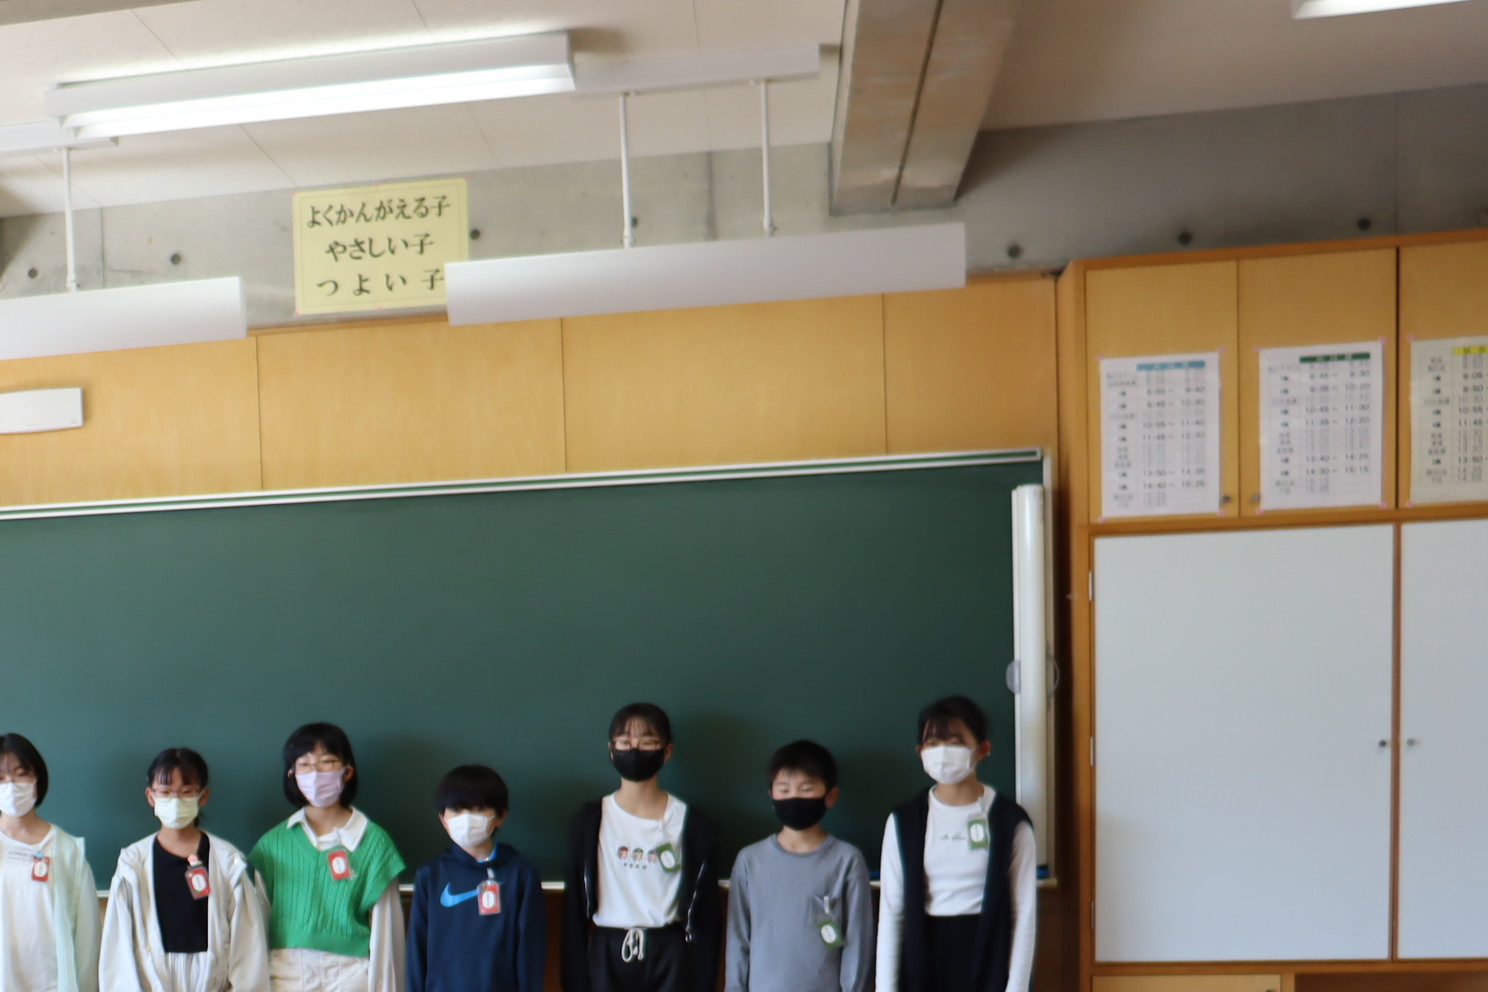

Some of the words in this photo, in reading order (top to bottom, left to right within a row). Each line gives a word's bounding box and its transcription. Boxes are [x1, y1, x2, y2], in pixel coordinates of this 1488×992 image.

[307, 195, 450, 228] よくかんがえる子
[325, 232, 434, 262] やさしい子
[316, 268, 445, 297] つよい子
